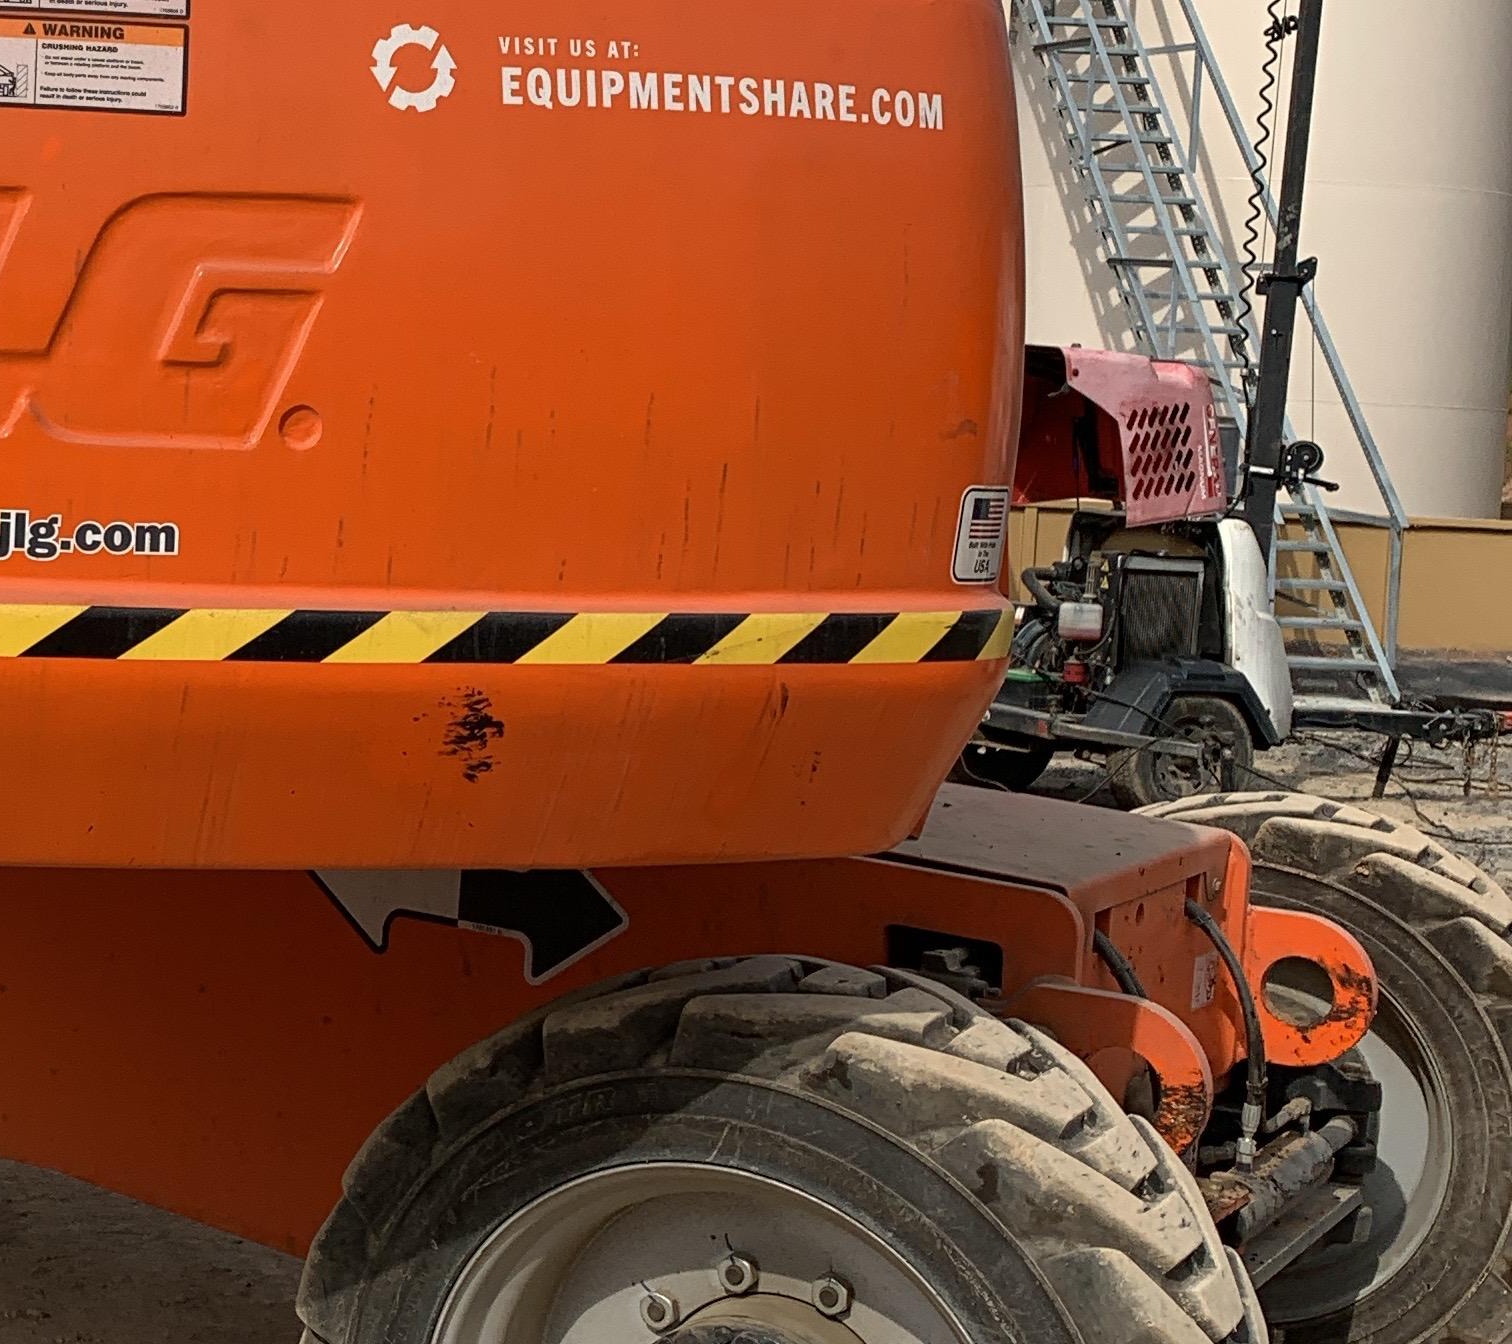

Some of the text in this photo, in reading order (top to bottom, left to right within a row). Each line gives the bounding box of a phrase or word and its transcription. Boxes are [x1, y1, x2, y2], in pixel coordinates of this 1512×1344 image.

[42, 23, 125, 40] WARNING
[41, 42, 119, 53] CRUSHING HAZARD
[497, 36, 640, 60] VISIT US AT:
[500, 66, 944, 131] EQUIPMENTSHARE.COM
[973, 558, 991, 574] USA
